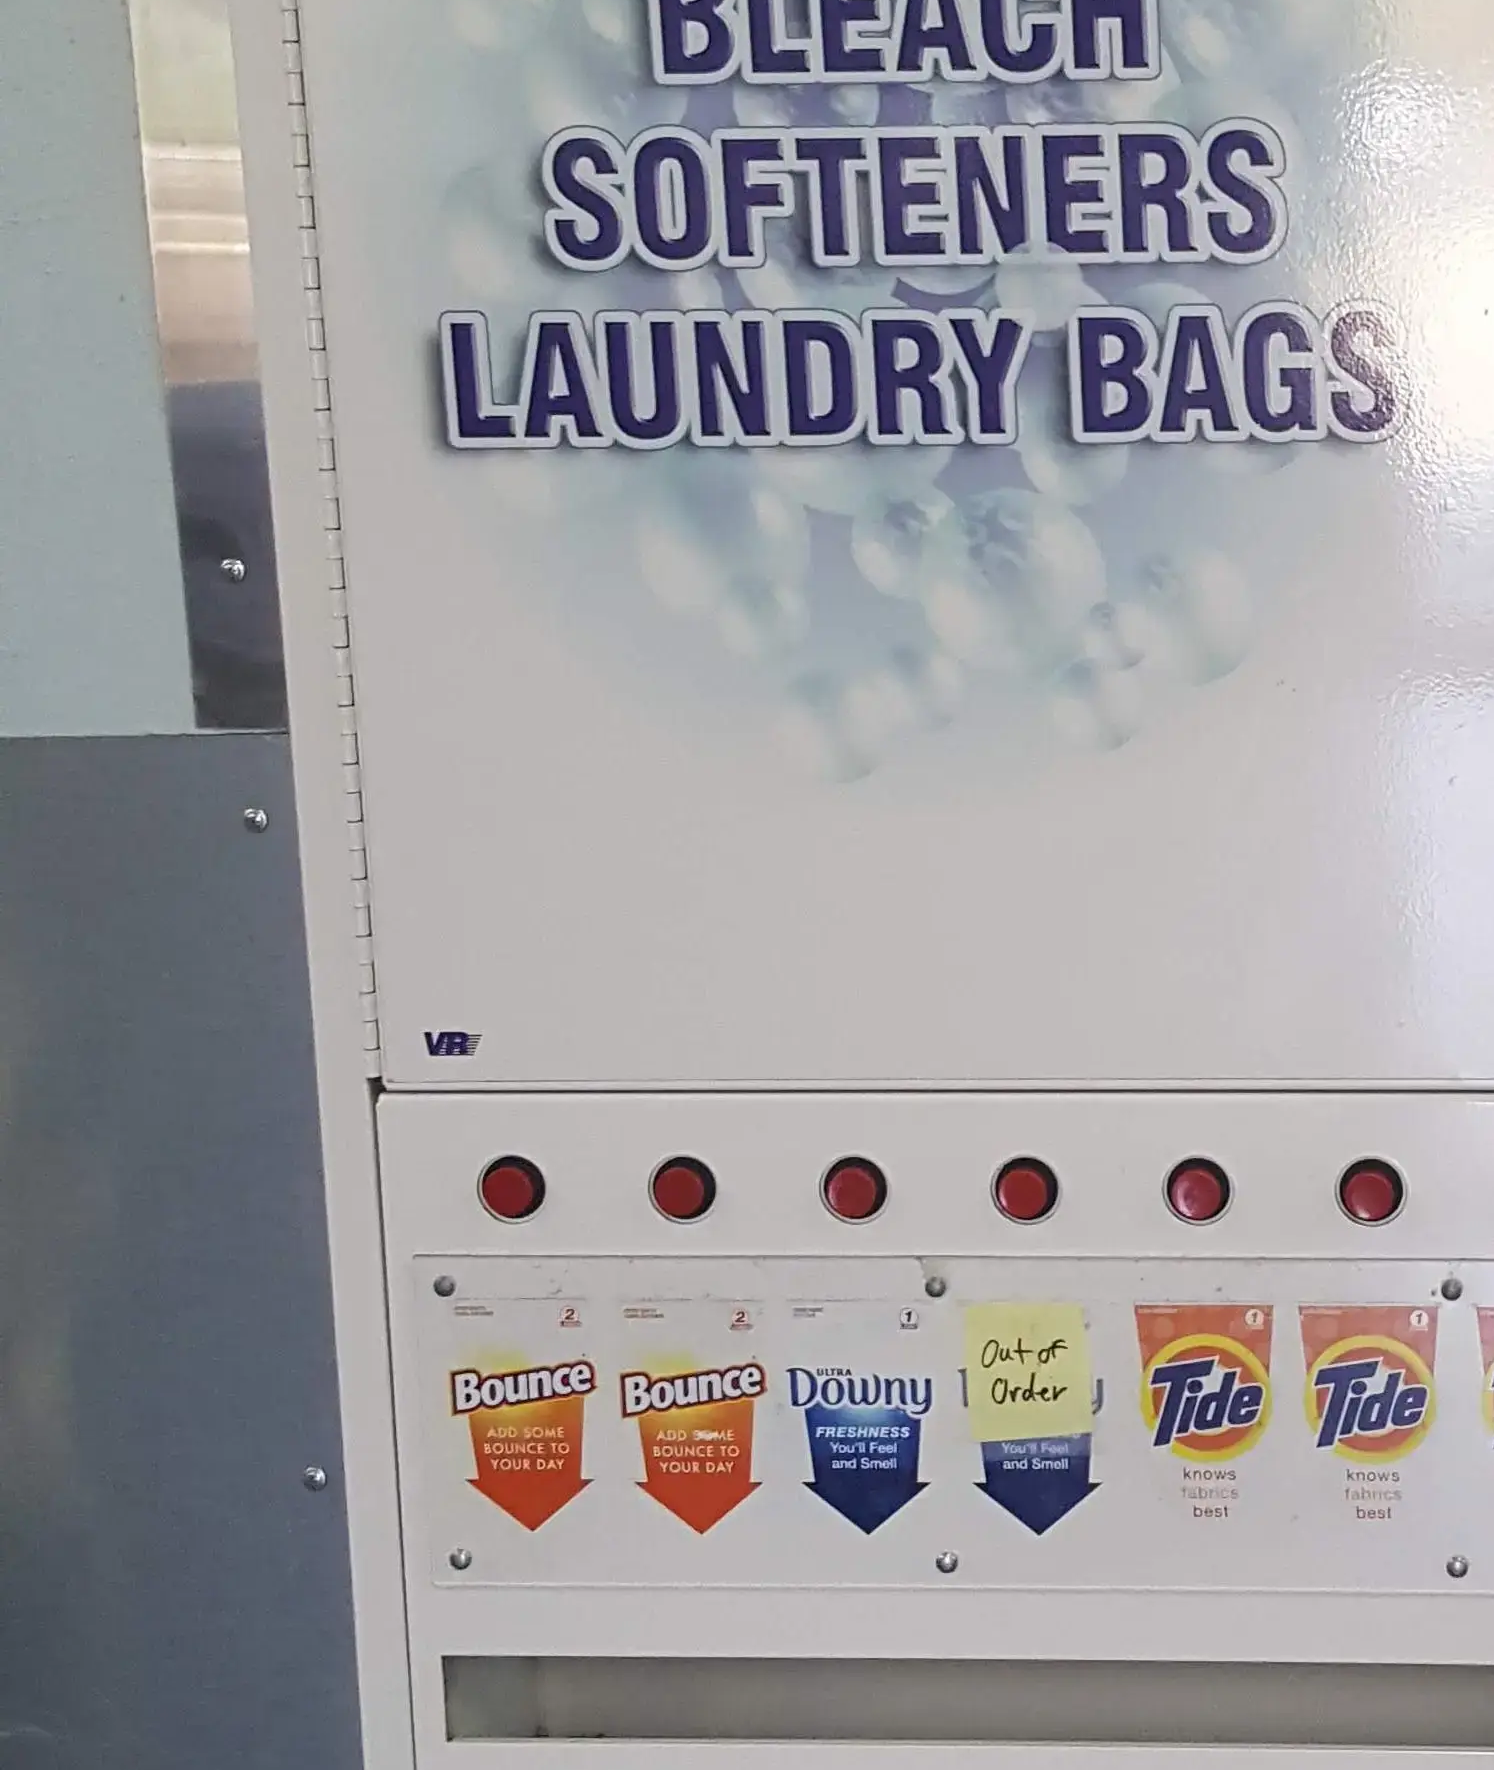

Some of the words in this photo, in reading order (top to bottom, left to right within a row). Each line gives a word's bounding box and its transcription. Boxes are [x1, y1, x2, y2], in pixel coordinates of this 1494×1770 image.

[551, 130, 1277, 261] SOFTENERS
[448, 317, 1024, 439] LAUNDRY
[1076, 312, 1401, 437] BAGS
[981, 1337, 1033, 1368] Out
[1037, 1339, 1068, 1364] of
[816, 1368, 852, 1377] ULTRA
[453, 1361, 595, 1415] Bounce
[622, 1365, 766, 1416] Bounce
[786, 1367, 932, 1414] Downy
[991, 1372, 1068, 1404] Order
[1151, 1357, 1264, 1448] Tide
[1315, 1358, 1428, 1448] Tide
[487, 1427, 517, 1438] ADD
[524, 1426, 564, 1438] SOME
[656, 1430, 688, 1442] ADD
[816, 1426, 910, 1438] FRESHNESS
[484, 1443, 547, 1455] BOUNCE
[551, 1442, 570, 1454] TO
[653, 1445, 715, 1457] BOUNCE
[720, 1445, 739, 1457] TO
[829, 1442, 865, 1453] You'll
[869, 1442, 898, 1453] Feel
[490, 1458, 532, 1470] YOUR
[536, 1458, 565, 1470] DAY
[660, 1461, 701, 1474] YOUR
[705, 1461, 735, 1473] DAY
[831, 1458, 858, 1469] and
[861, 1458, 898, 1469] Smell
[1003, 1458, 1028, 1469] and
[1032, 1458, 1069, 1469] Smell
[1183, 1467, 1237, 1481] knows
[1346, 1469, 1400, 1482] knows
[1192, 1504, 1229, 1518] best
[1355, 1506, 1392, 1520] best
